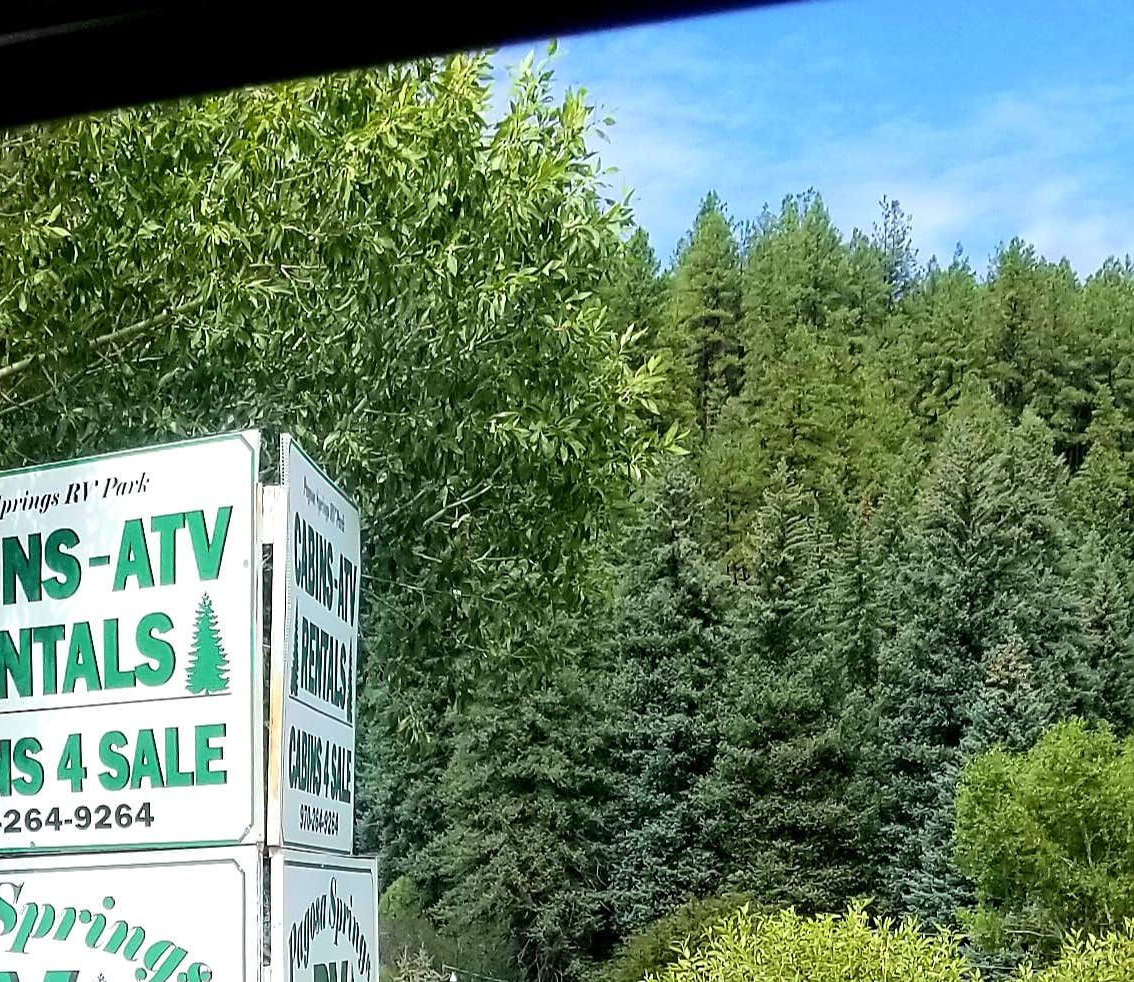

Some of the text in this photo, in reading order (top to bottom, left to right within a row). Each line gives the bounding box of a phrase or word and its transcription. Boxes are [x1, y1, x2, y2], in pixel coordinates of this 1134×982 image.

[65, 479, 99, 505] RV
[103, 472, 150, 499] Park
[300, 620, 347, 710] RENTALS
[56, 732, 87, 793] 4
[98, 723, 227, 790] SALE
[289, 725, 352, 804] CABINS 4 SALE
[329, 877, 371, 982] Springs
